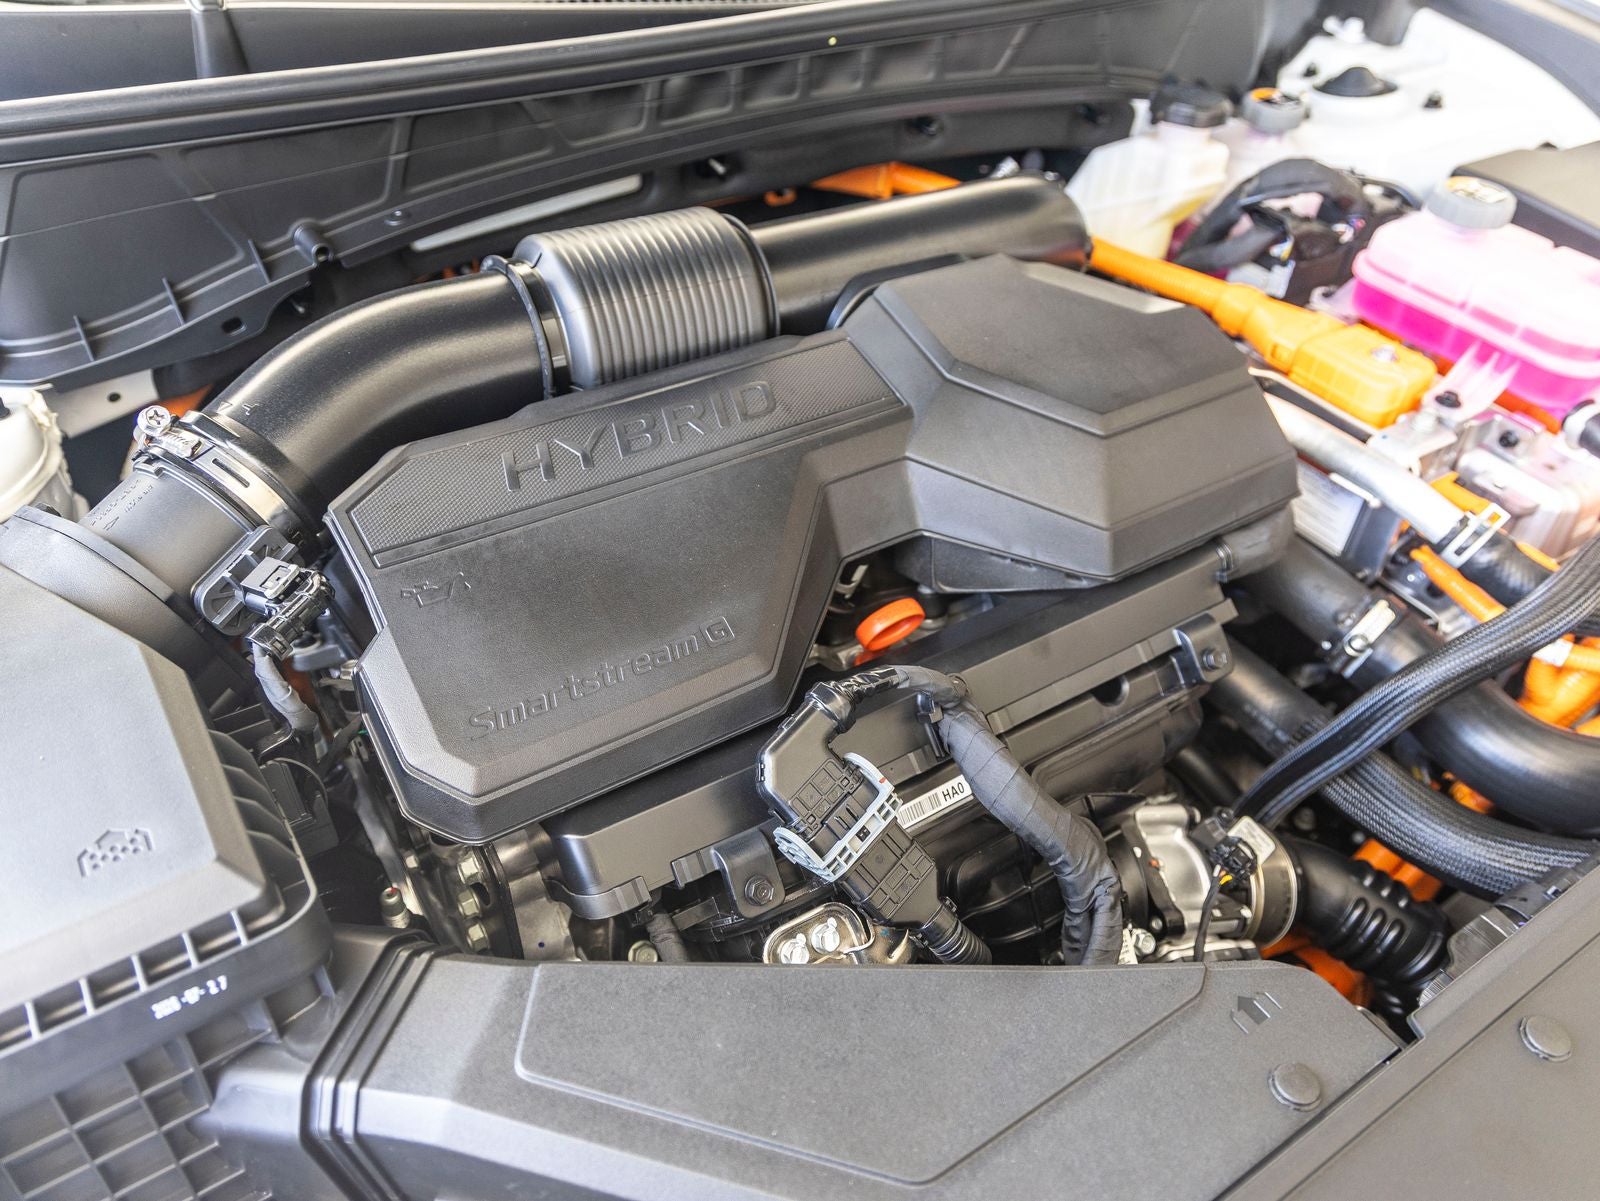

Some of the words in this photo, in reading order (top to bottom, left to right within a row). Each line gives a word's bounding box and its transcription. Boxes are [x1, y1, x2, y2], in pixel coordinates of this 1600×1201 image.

[501, 380, 777, 492] HYBRID
[468, 634, 700, 741] Smartstream
[704, 619, 731, 645] G
